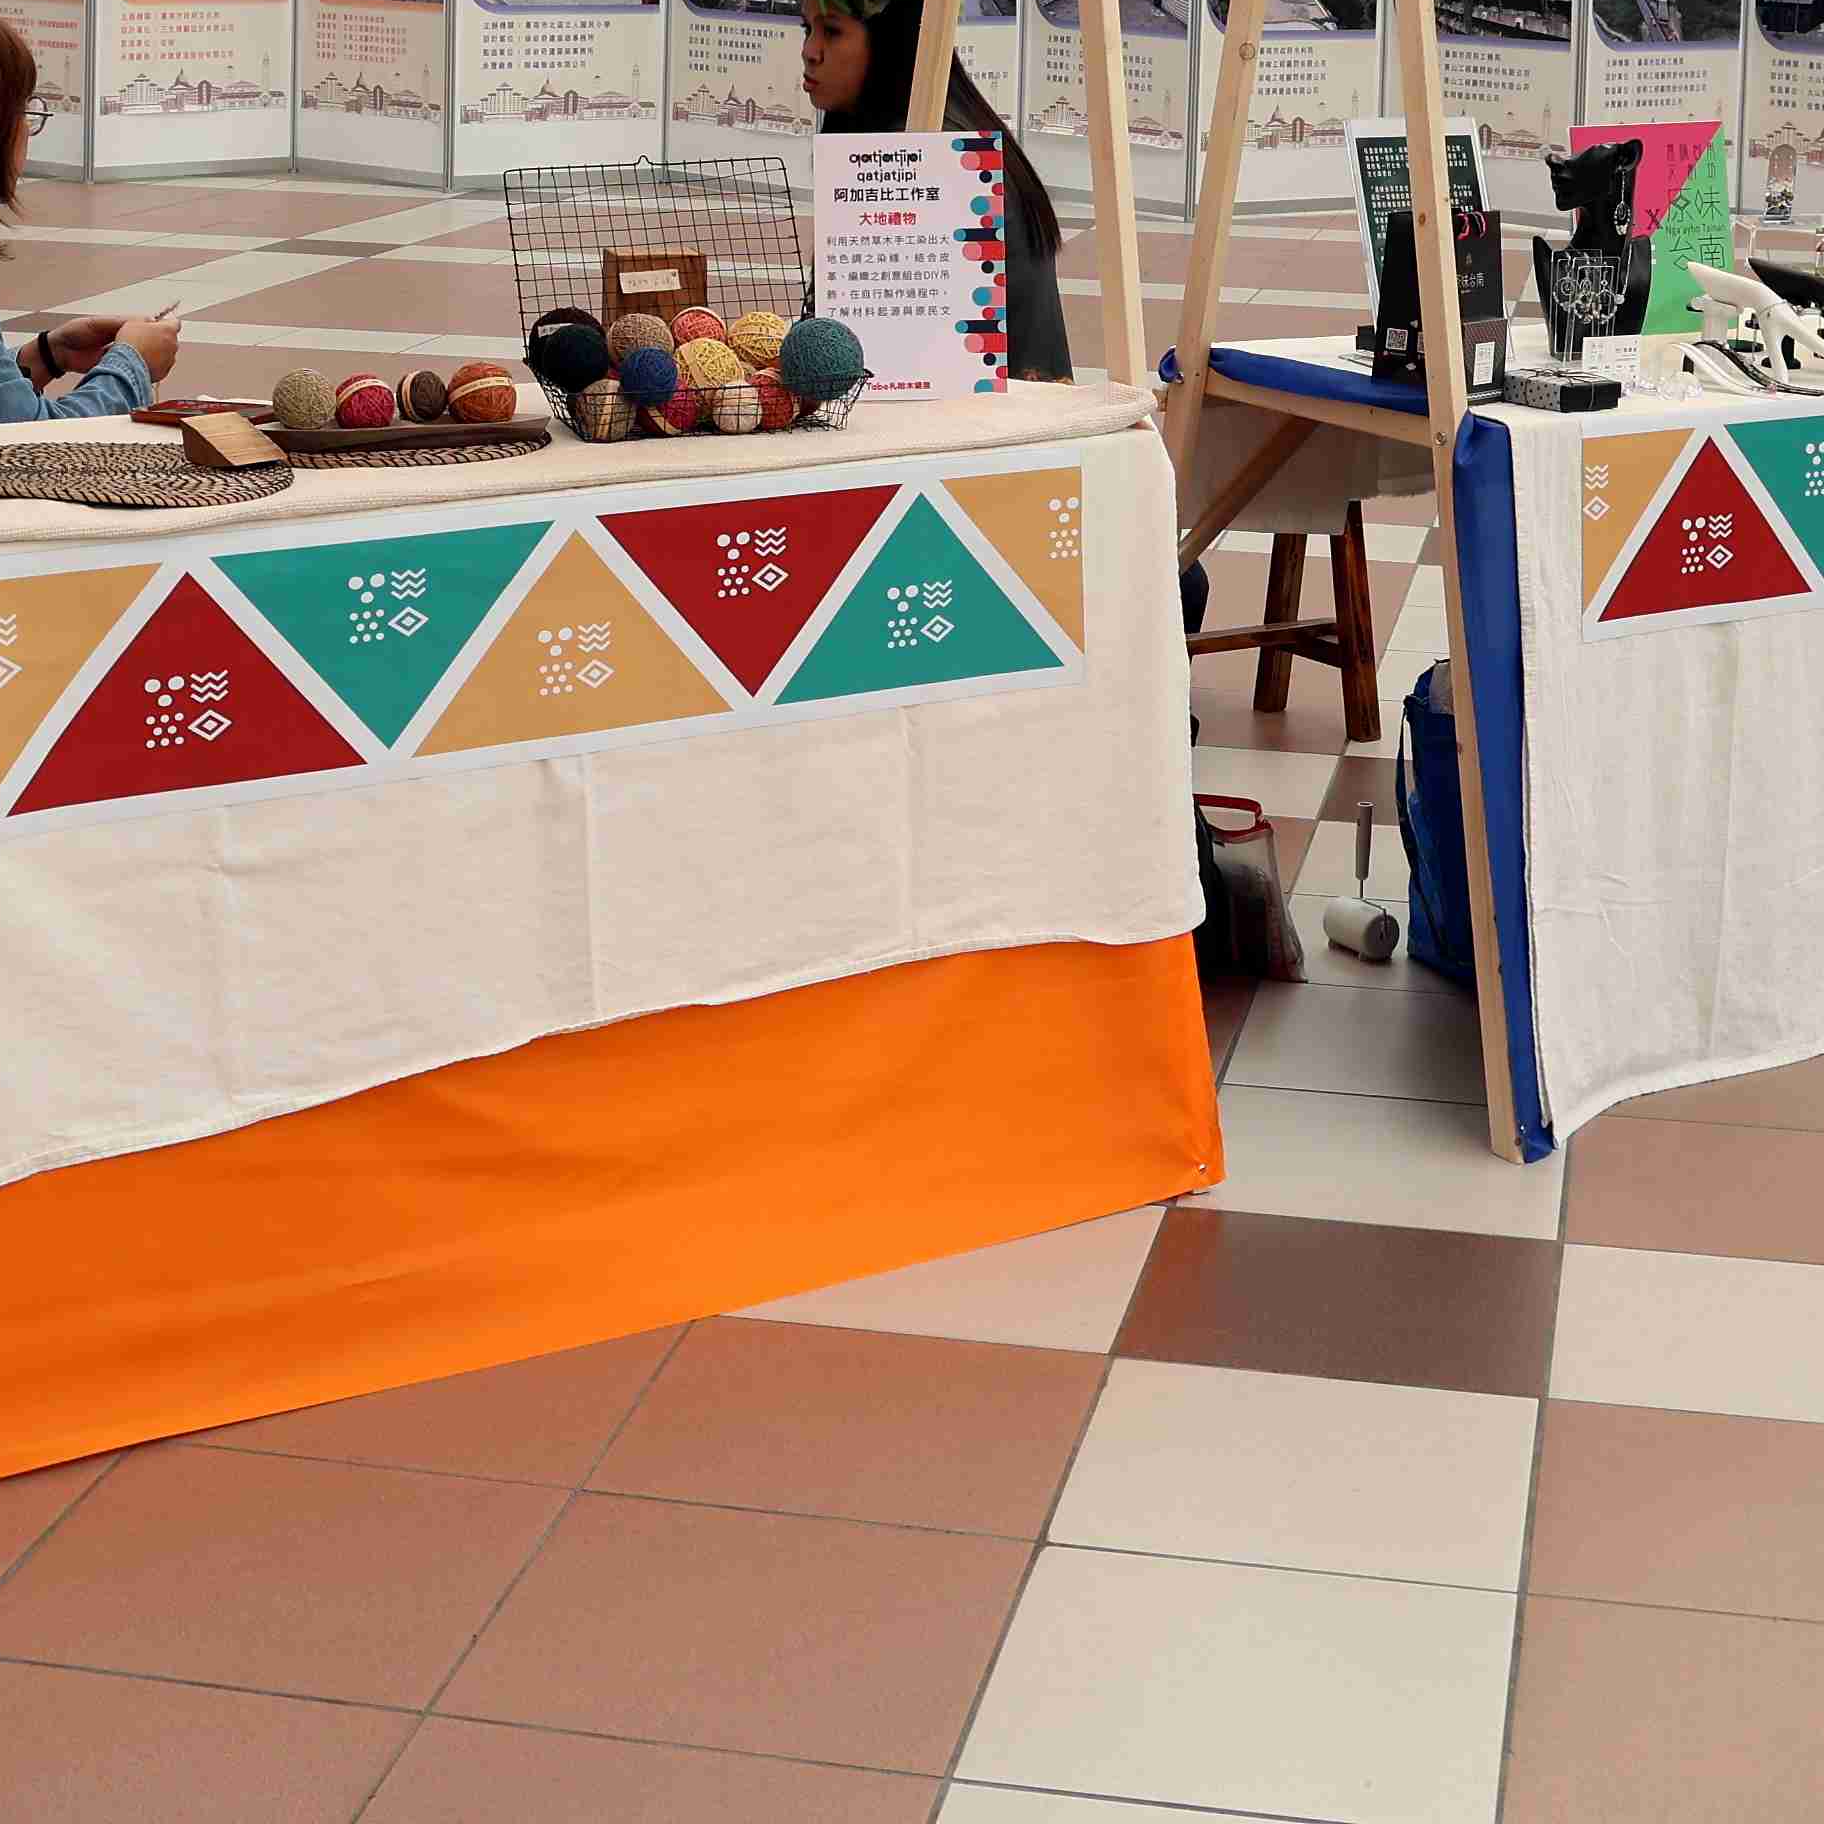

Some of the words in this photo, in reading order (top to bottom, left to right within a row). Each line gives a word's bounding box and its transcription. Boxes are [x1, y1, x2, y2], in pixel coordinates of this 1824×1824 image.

[856, 168, 917, 183] qatjatjipi
[834, 187, 941, 203] 阿加吉比工作室
[859, 212, 917, 226] 大地禮物
